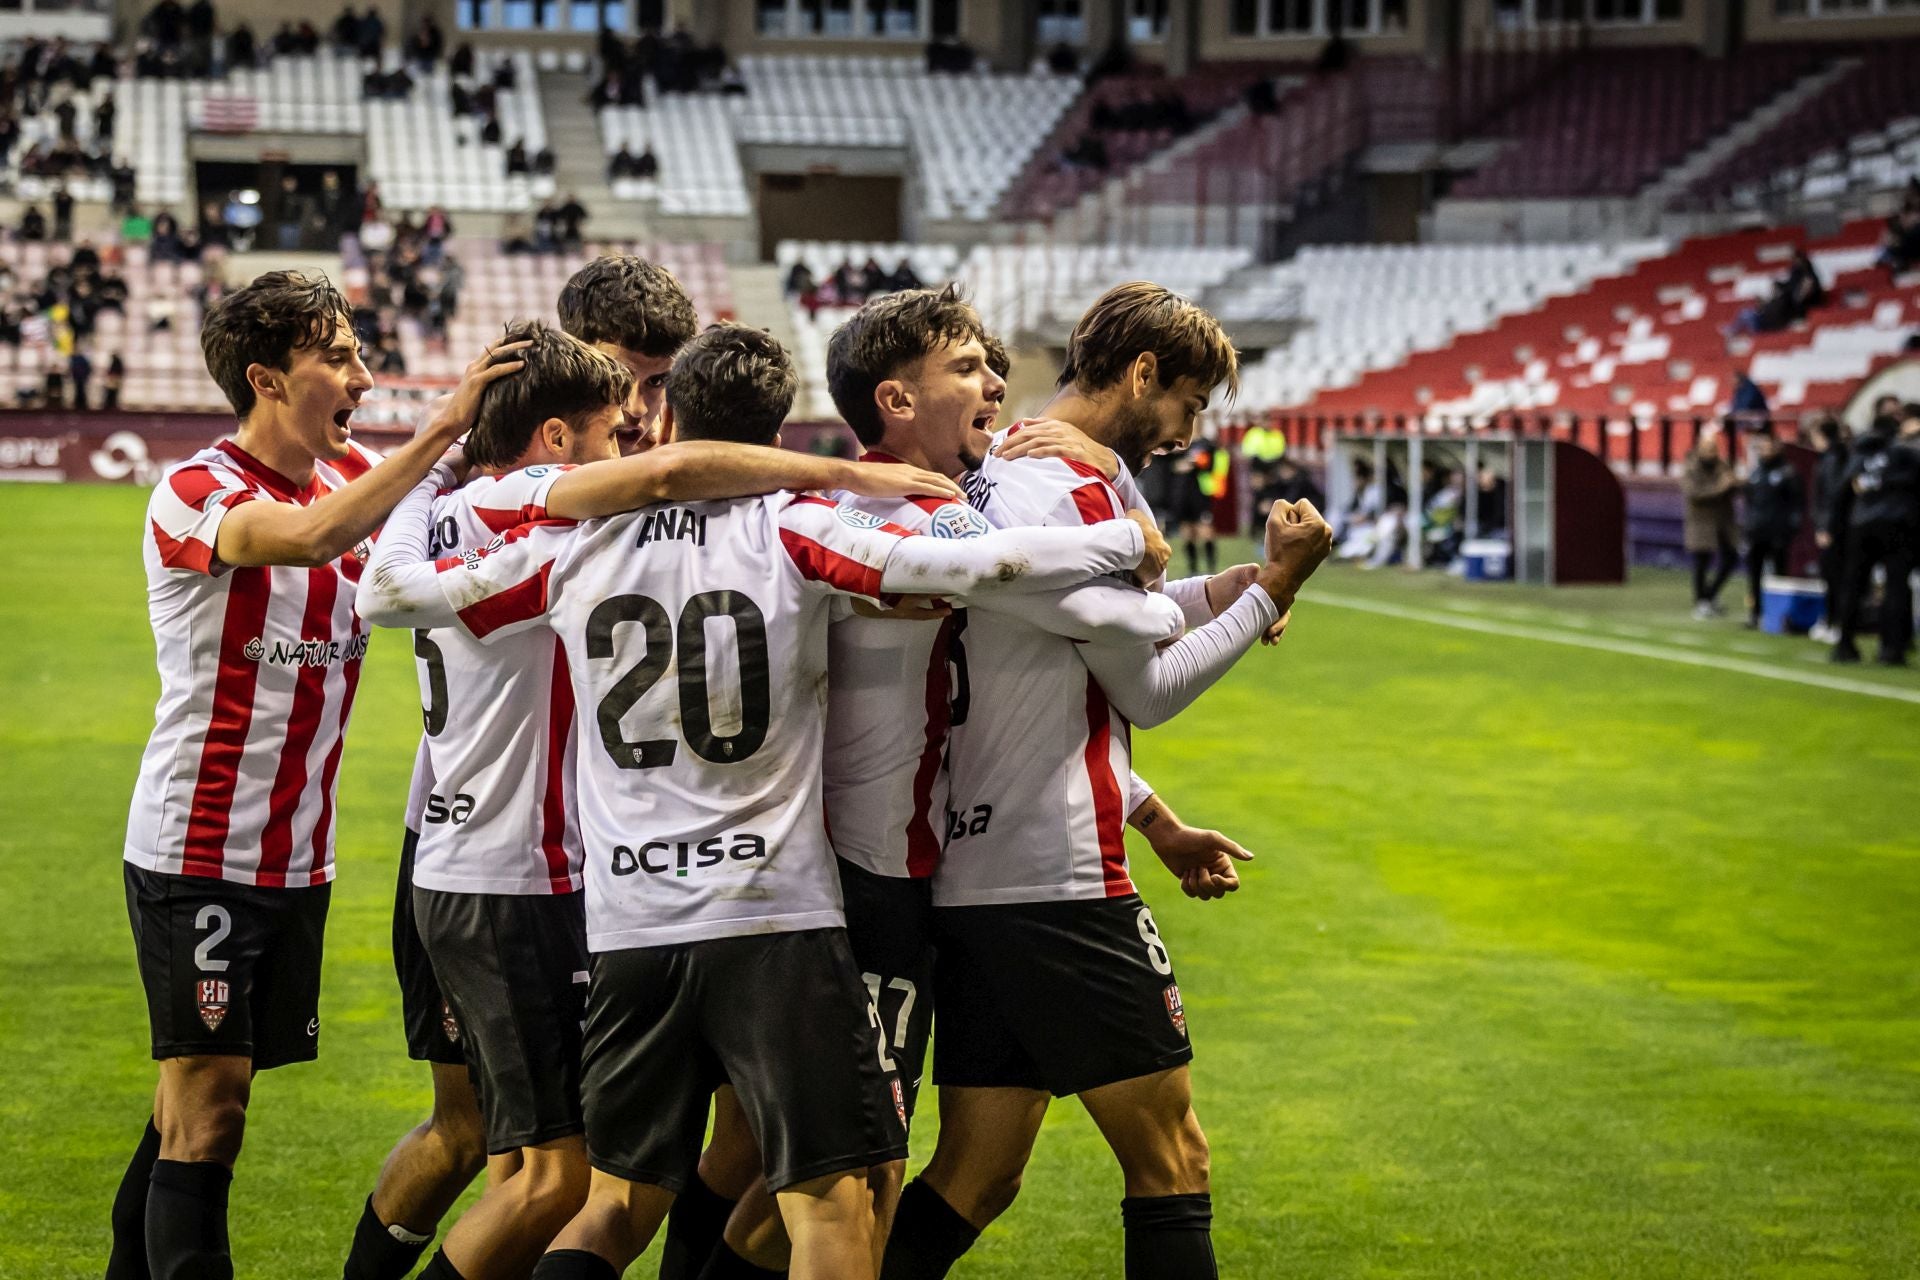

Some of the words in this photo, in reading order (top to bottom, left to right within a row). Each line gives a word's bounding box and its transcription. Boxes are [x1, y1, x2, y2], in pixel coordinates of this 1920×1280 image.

[268, 638, 340, 666] NATUR
[586, 589, 770, 769] 20
[194, 904, 232, 972] 2
[1136, 906, 1172, 976] 8
